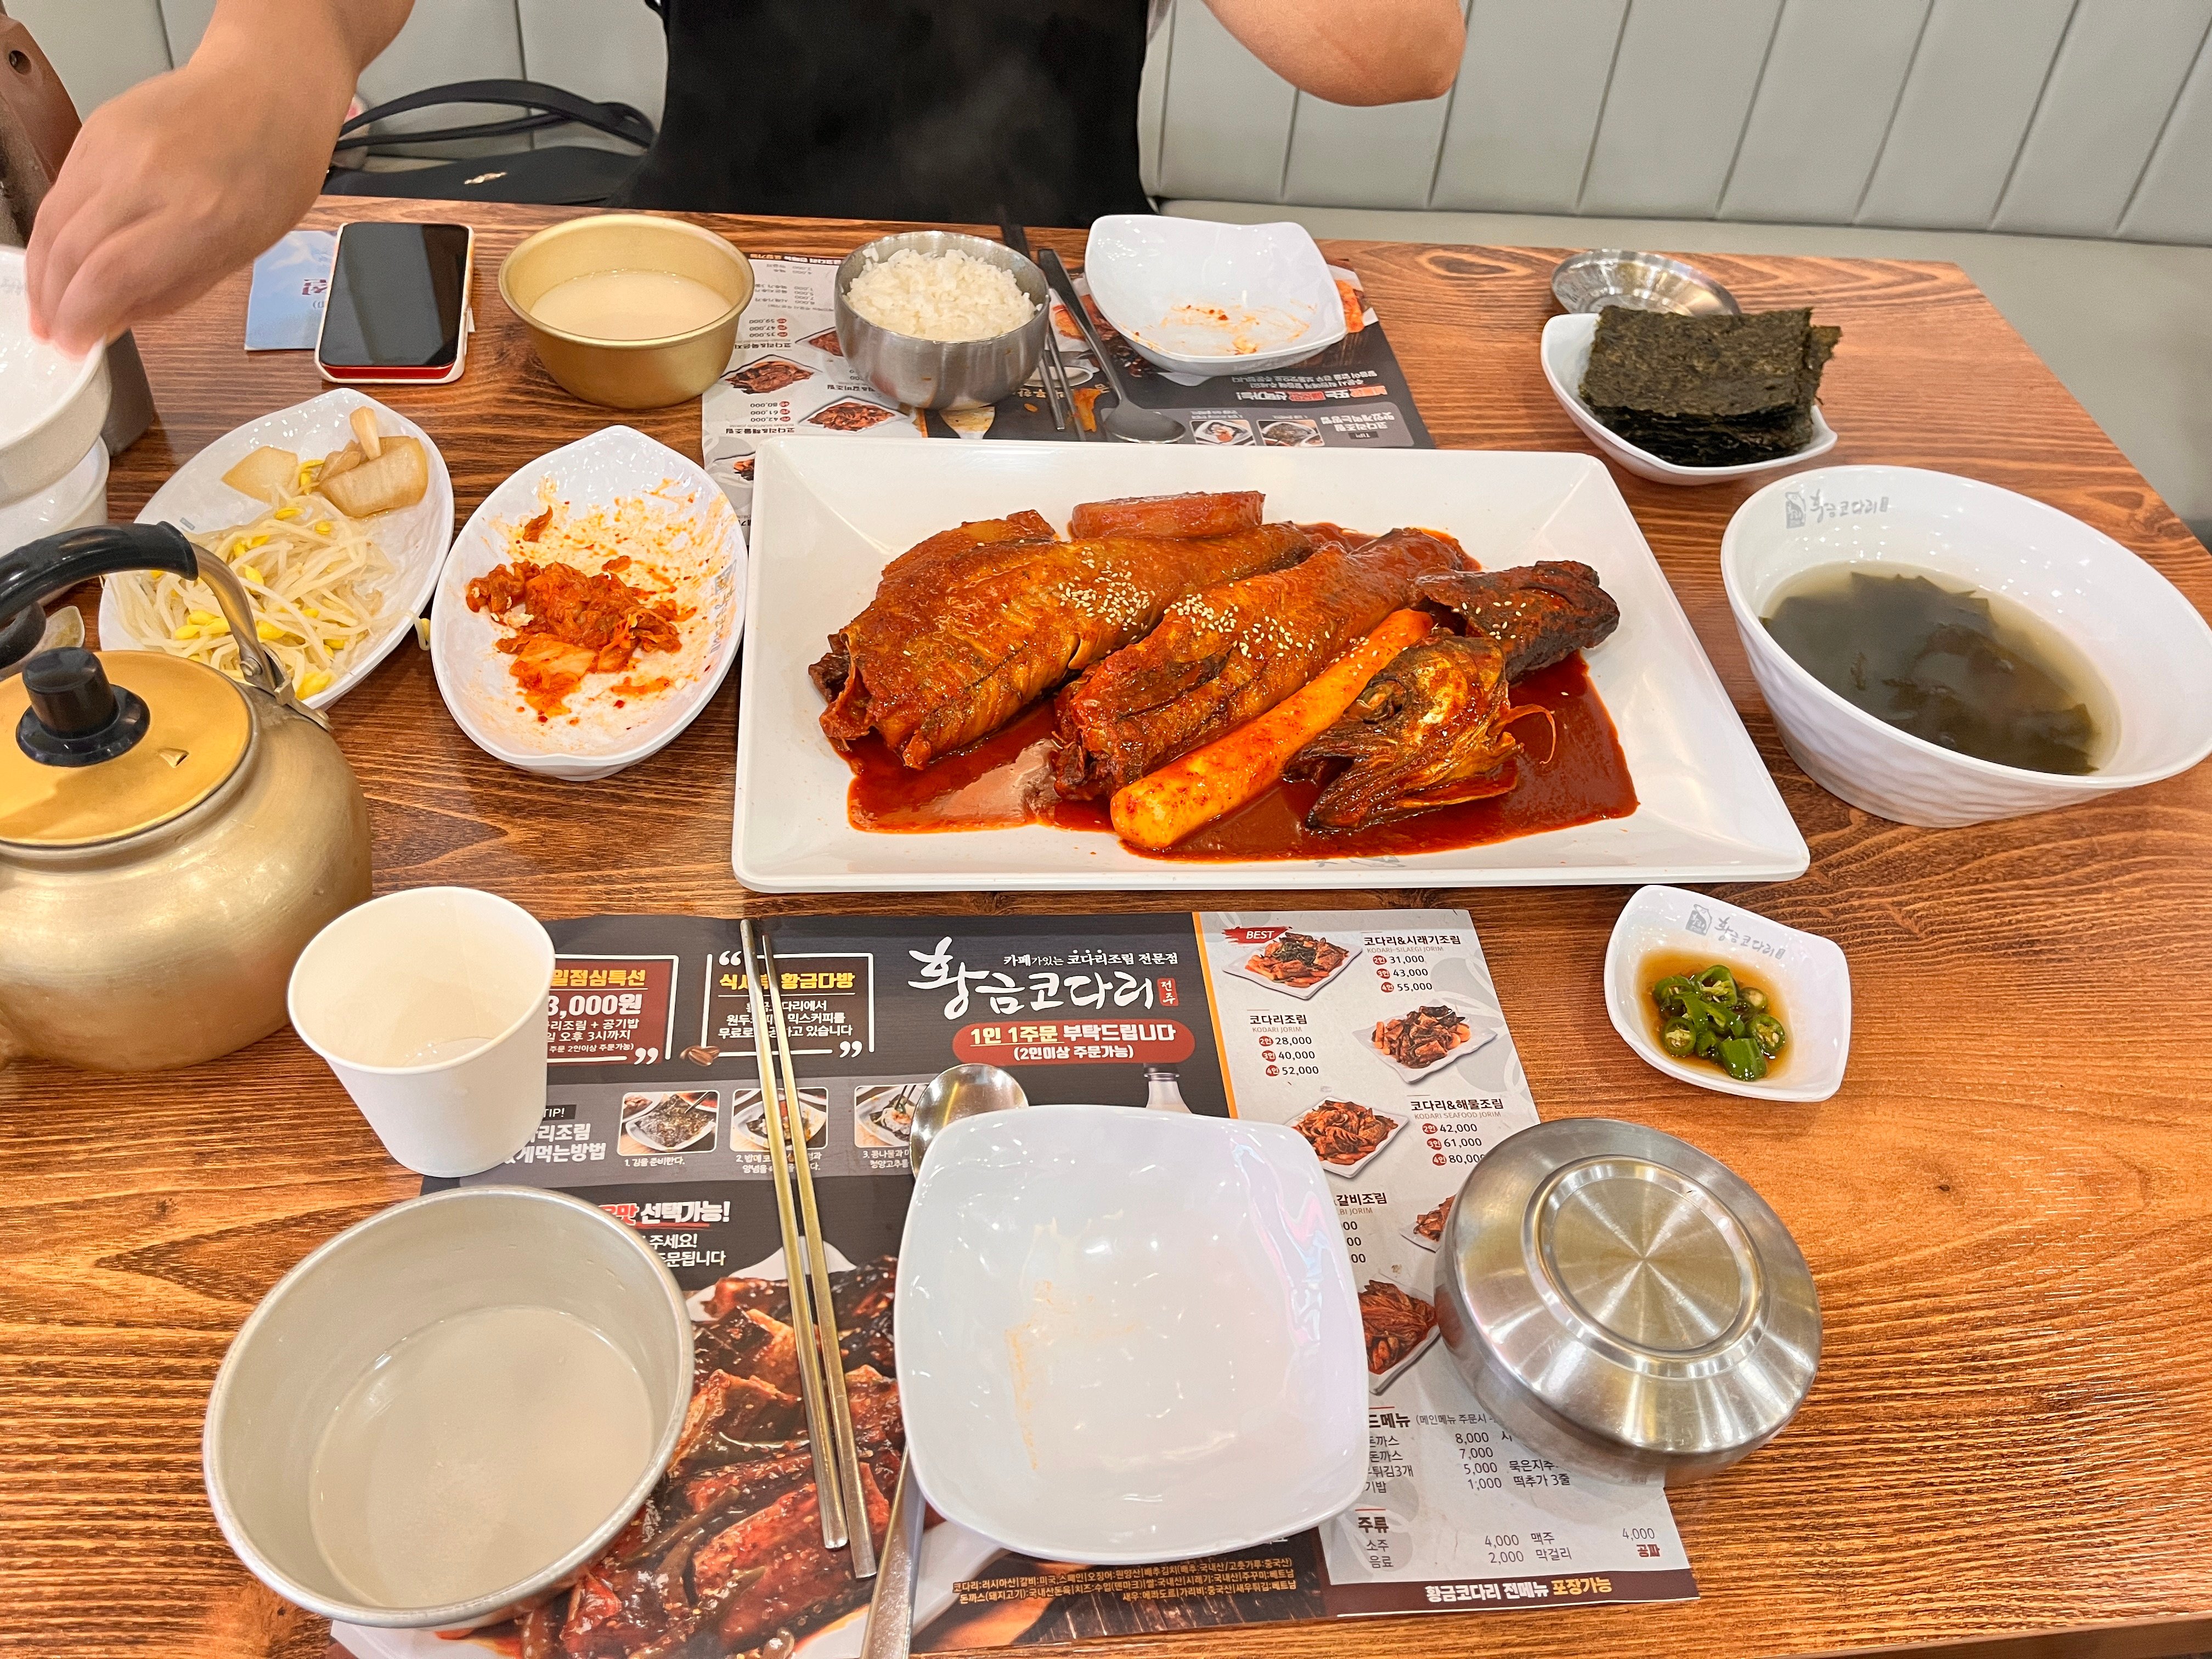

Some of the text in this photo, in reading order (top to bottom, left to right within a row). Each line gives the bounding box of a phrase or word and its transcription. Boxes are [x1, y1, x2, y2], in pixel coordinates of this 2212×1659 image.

[1246, 930, 1275, 939] BEST
[1364, 935, 1462, 946] 코다리&시래기조림
[1003, 951, 1178, 967] 카페가있는 코다리조림 전문점
[1373, 955, 1425, 965] 2인 31,000
[908, 936, 1154, 1020] 황금코다리
[1377, 968, 1429, 978] 3인 43,000
[781, 972, 855, 990] 황금다방
[1397, 983, 1433, 992] 55,000
[547, 1020, 587, 1031] 리조림
[603, 1018, 640, 1030] 공기밥
[787, 1012, 845, 1025] 믹스커피를
[1250, 1014, 1307, 1025] 코다리조림
[559, 1031, 583, 1042] 오후
[588, 1029, 631, 1042] 3시까지
[718, 1026, 754, 1040] 무료로
[805, 1024, 853, 1037] 있습니다
[970, 1024, 1177, 1045] 1인 1주문 부탁드립니다
[1275, 1036, 1312, 1046] 28,000
[567, 1044, 597, 1053] 2인이상
[599, 1043, 634, 1052] 주문가능)
[1013, 1044, 1134, 1061] (2인이상 주문가능)
[1279, 1051, 1316, 1060] 40,000
[1282, 1066, 1319, 1076] 52,000
[1410, 1098, 1504, 1111] 코다리&해물조림
[1440, 1124, 1477, 1133] 42,000
[1427, 1138, 1482, 1149] 3인 61,000
[1434, 1156, 1446, 1164] 4인
[1334, 1192, 1387, 1206] 갈비조림
[640, 1200, 731, 1225] 선택가능!
[1350, 1207, 1373, 1216] JORIM
[649, 1233, 698, 1250] 주세요!
[1415, 1414, 1456, 1425] (메인메뉴
[1458, 1413, 1487, 1425] 주문시
[1455, 1432, 1489, 1445] 8,000
[1459, 1447, 1493, 1460] 7,000
[1368, 1464, 1414, 1478] 튀김3개
[1464, 1462, 1498, 1476] 5,000
[1468, 1477, 1502, 1491] 1,000
[1513, 1474, 1548, 1488] 떡추가
[1550, 1473, 1571, 1486] 3줄
[1358, 1516, 1389, 1533] 주류
[1366, 1527, 1655, 1553] 소주 4,000 맥주 4,000
[1369, 1555, 1394, 1568] 음료
[1488, 1550, 1524, 1565] 2,000
[1536, 1547, 1572, 1561] 막걸리
[1425, 1577, 1612, 1602] 황금코다리 전메뉴 포장가능
